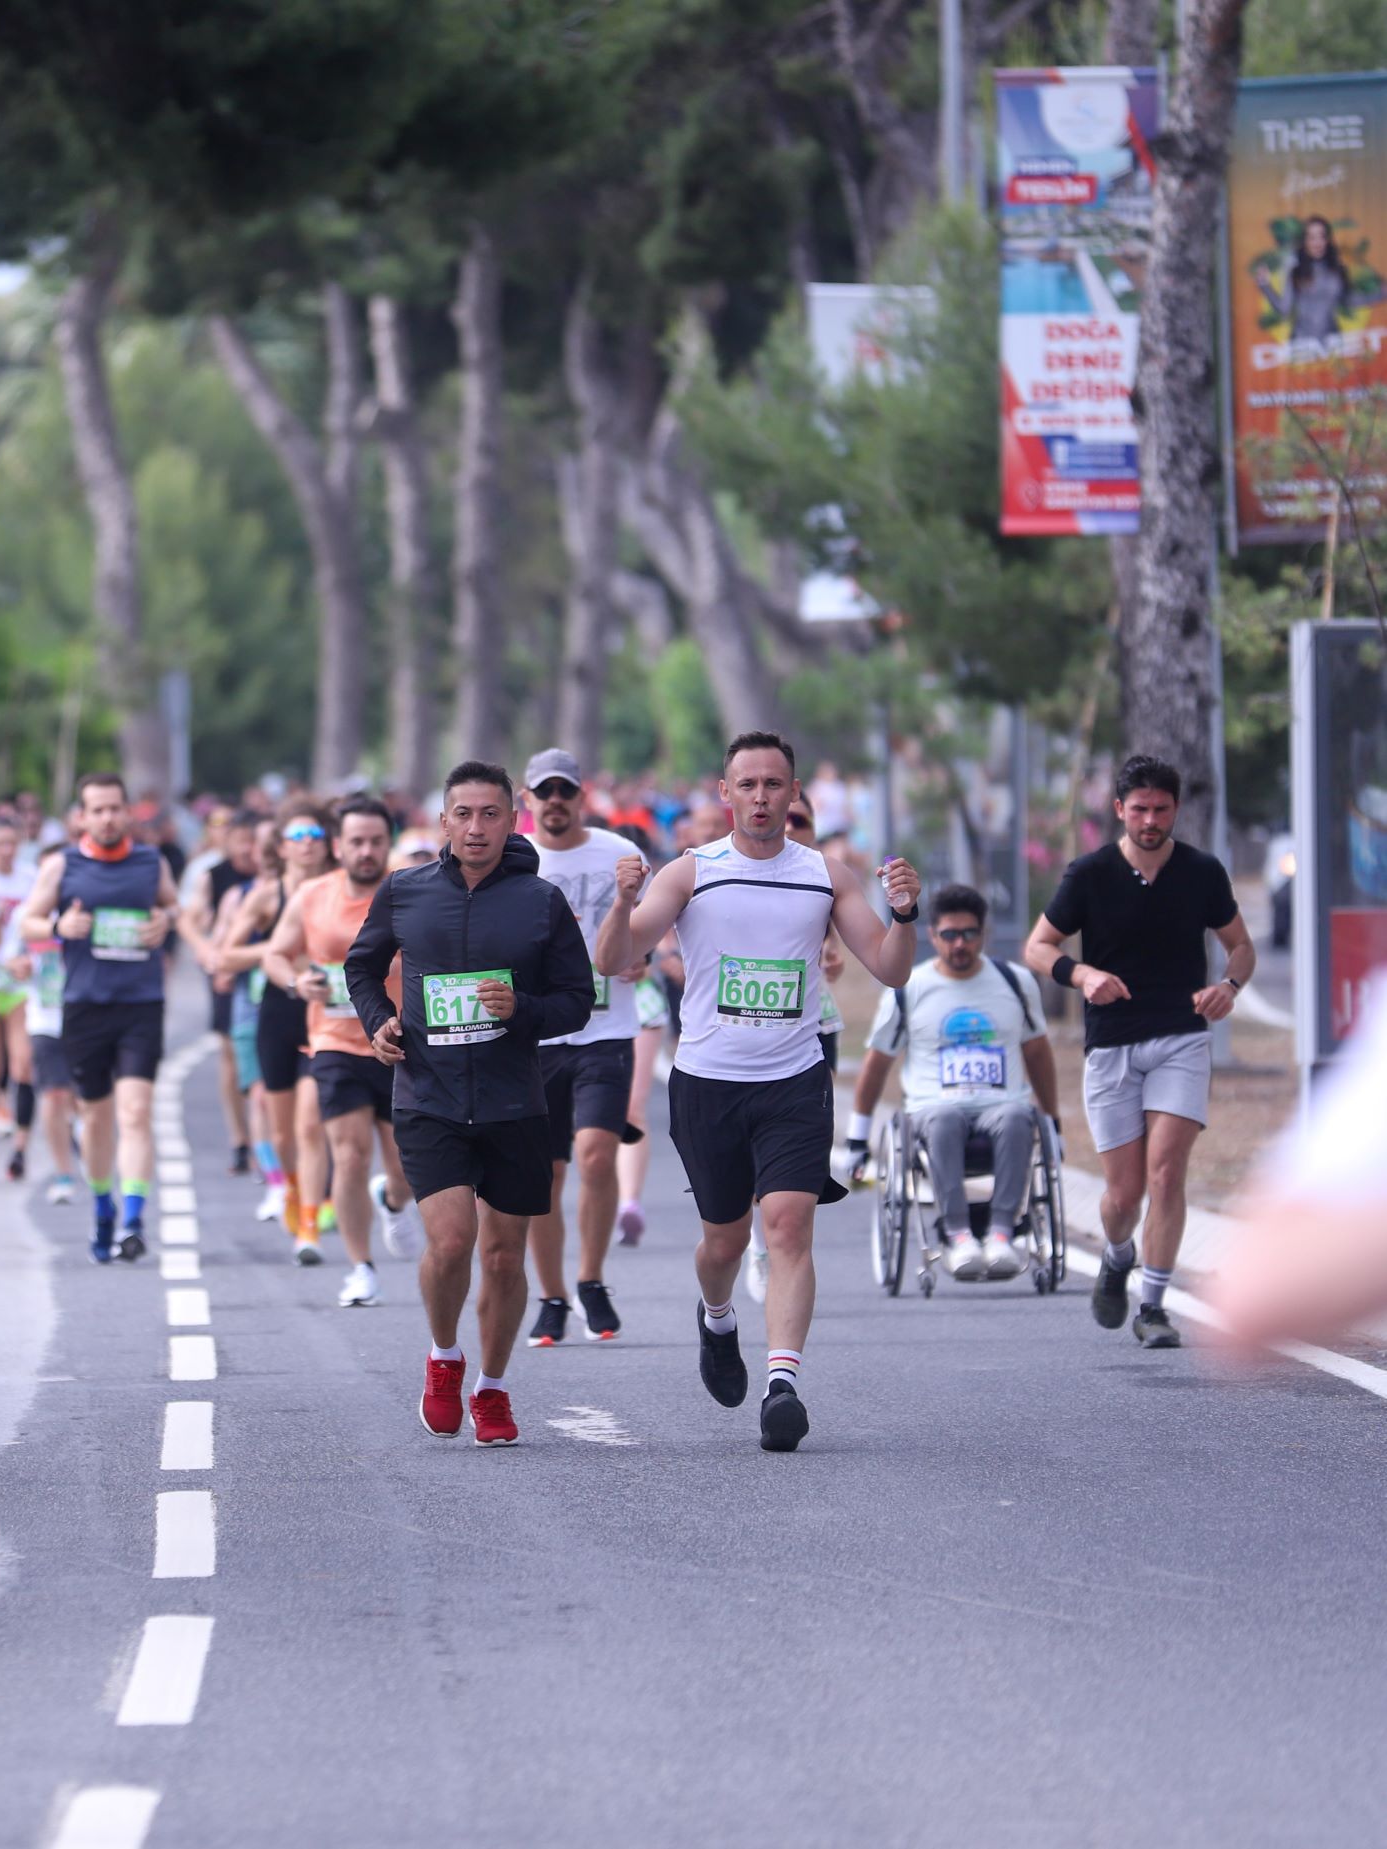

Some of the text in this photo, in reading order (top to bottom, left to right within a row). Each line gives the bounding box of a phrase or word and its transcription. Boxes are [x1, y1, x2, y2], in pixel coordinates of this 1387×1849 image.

[1258, 114, 1365, 152] THREE
[1045, 320, 1122, 340] DOĞA
[1045, 351, 1122, 370] DENİZ
[725, 978, 797, 1008] 6067
[432, 994, 485, 1024] 617
[740, 1009, 784, 1018] SALOMON
[449, 1022, 493, 1033] SALOMON
[946, 1061, 999, 1084] 1438
